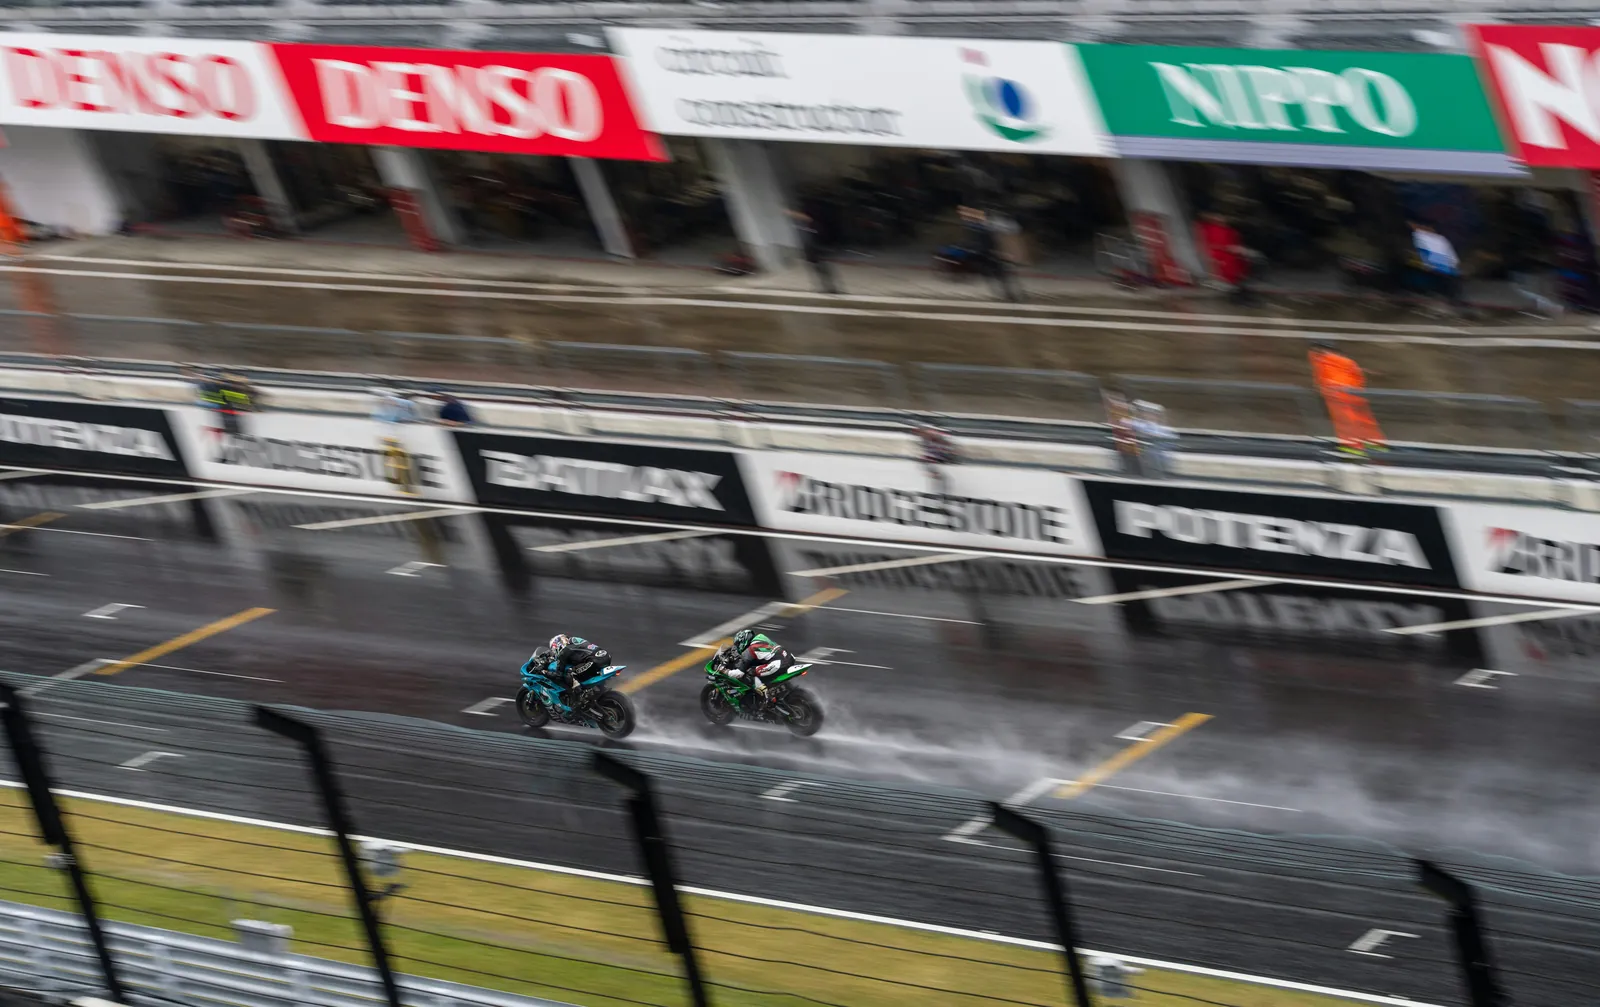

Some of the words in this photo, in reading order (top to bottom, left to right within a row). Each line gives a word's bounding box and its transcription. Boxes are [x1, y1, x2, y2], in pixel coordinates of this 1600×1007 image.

[2, 46, 260, 122] DENSO
[310, 58, 604, 142] DENSO
[1147, 61, 1419, 138] NIPPO
[1483, 41, 1600, 150] N
[479, 449, 727, 512] BATTLAX
[774, 470, 1074, 546] BRIDGESTONE
[1113, 499, 1432, 570] POTENZA
